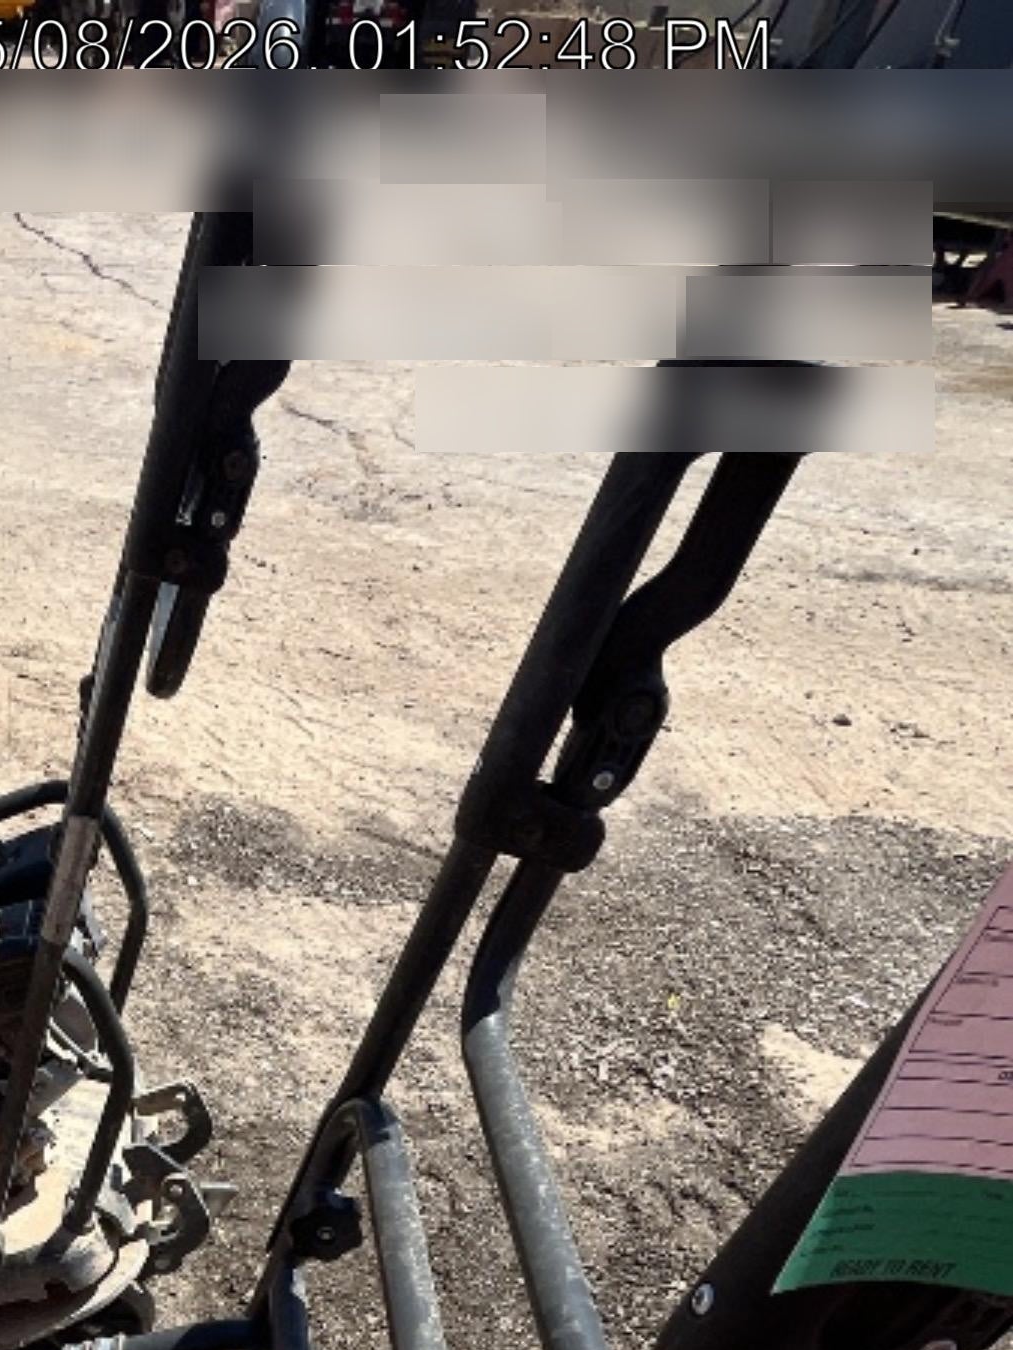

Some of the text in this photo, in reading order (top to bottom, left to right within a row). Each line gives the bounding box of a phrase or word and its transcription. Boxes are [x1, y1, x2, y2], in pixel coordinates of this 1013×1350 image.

[830, 1259, 957, 1279] READY TO RENT
